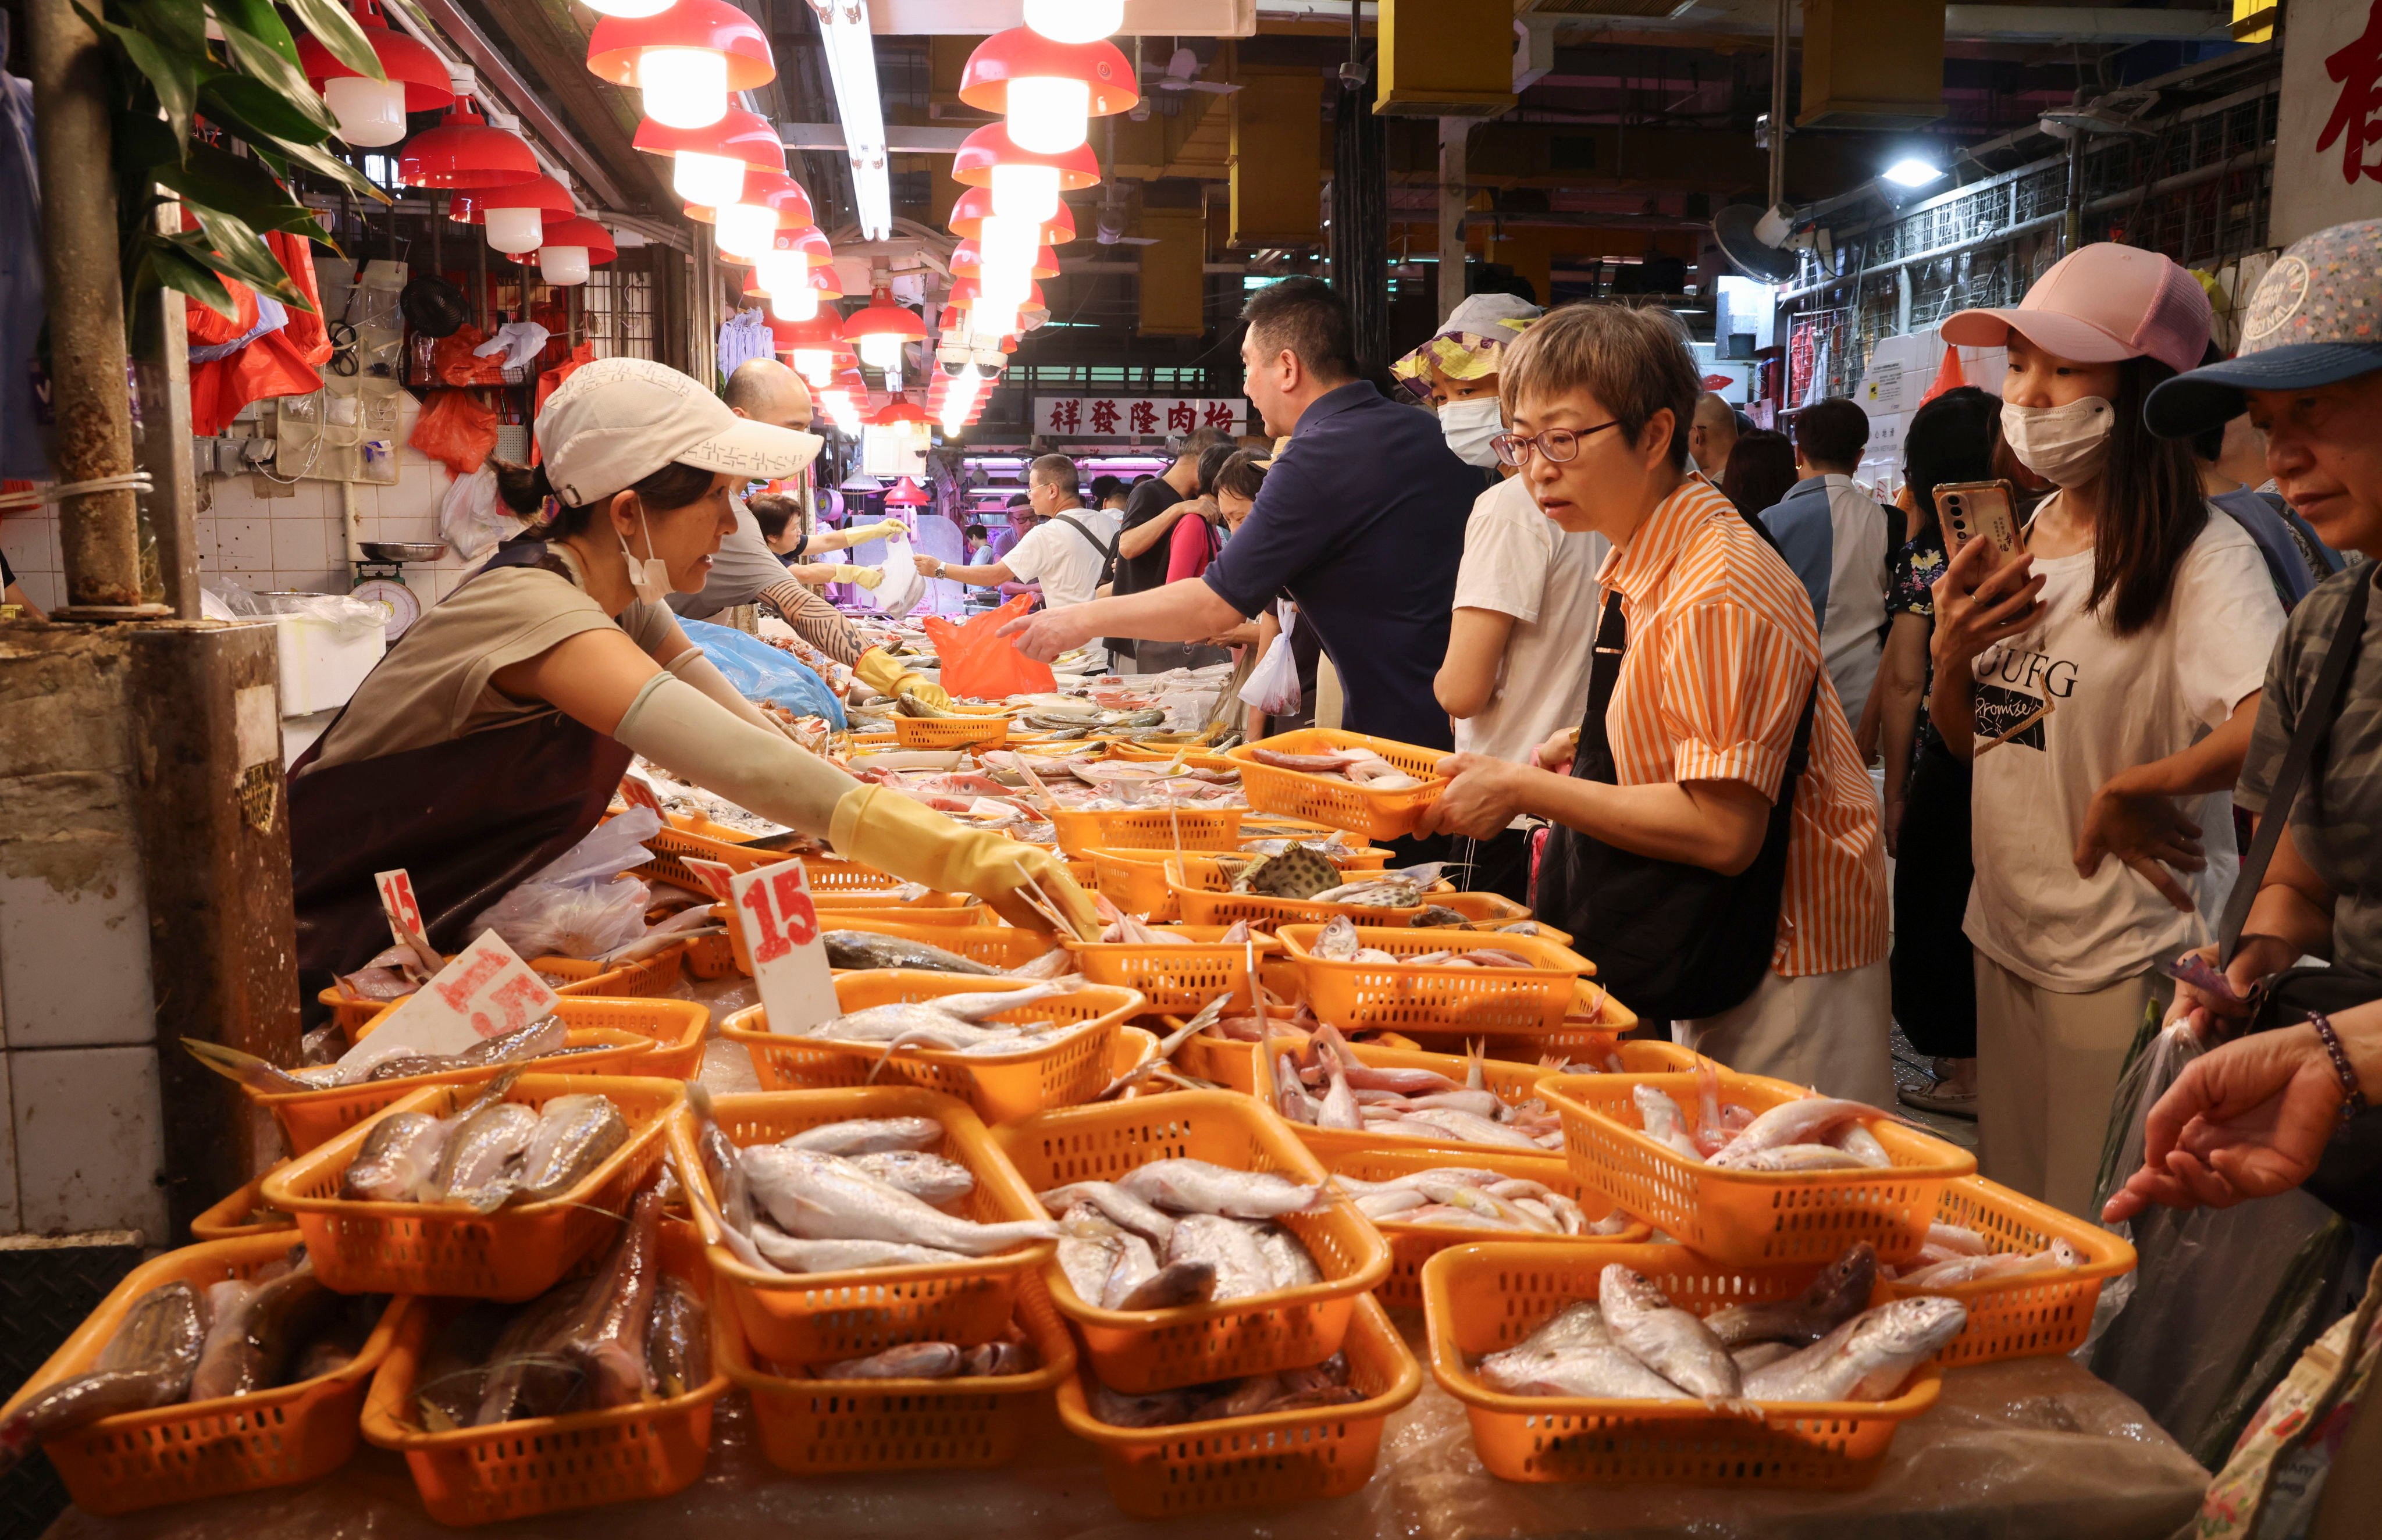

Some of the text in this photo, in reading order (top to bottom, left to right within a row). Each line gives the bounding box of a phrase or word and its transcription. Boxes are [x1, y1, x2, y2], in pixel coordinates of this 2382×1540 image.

[1050, 399, 1234, 434] 祥發隆肉枱
[383, 873, 420, 935] 15
[742, 867, 817, 964] 15
[434, 948, 549, 1039] 15
